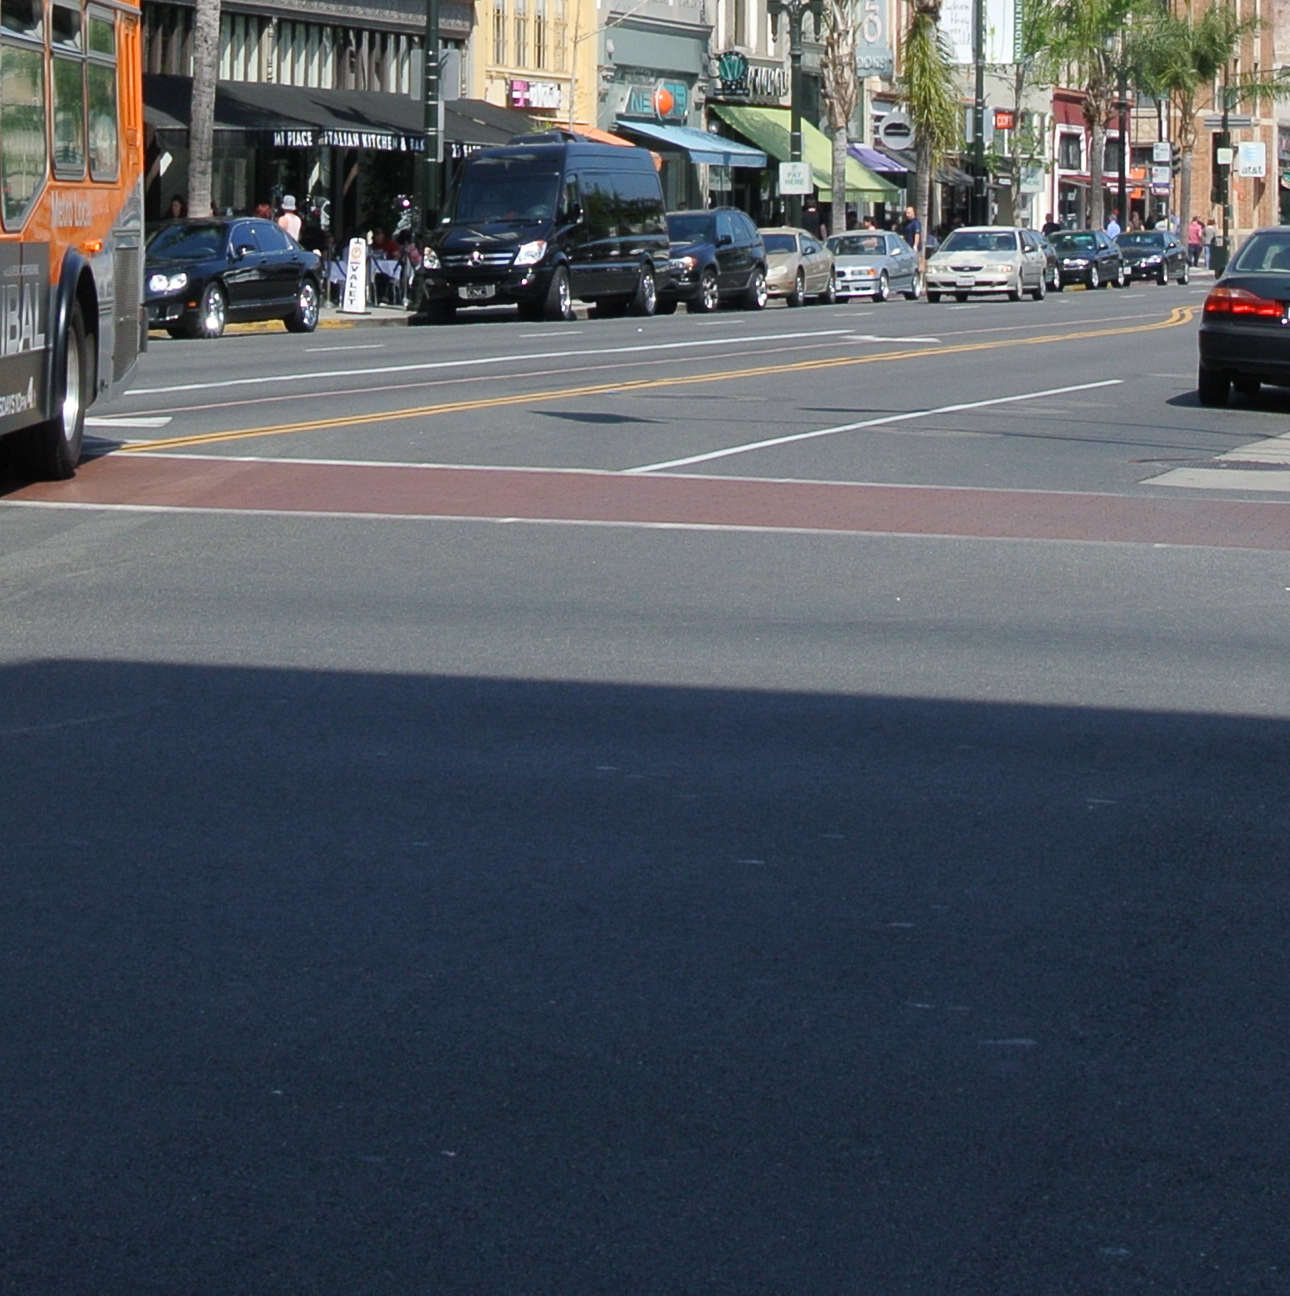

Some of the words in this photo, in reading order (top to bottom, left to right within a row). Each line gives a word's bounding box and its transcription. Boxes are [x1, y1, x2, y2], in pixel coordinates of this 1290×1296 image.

[324, 130, 359, 147] ITALIAN
[362, 133, 398, 151] KITCHEN
[400, 136, 407, 151] &
[1241, 165, 1263, 175] at&t
[350, 264, 359, 305] VALET
